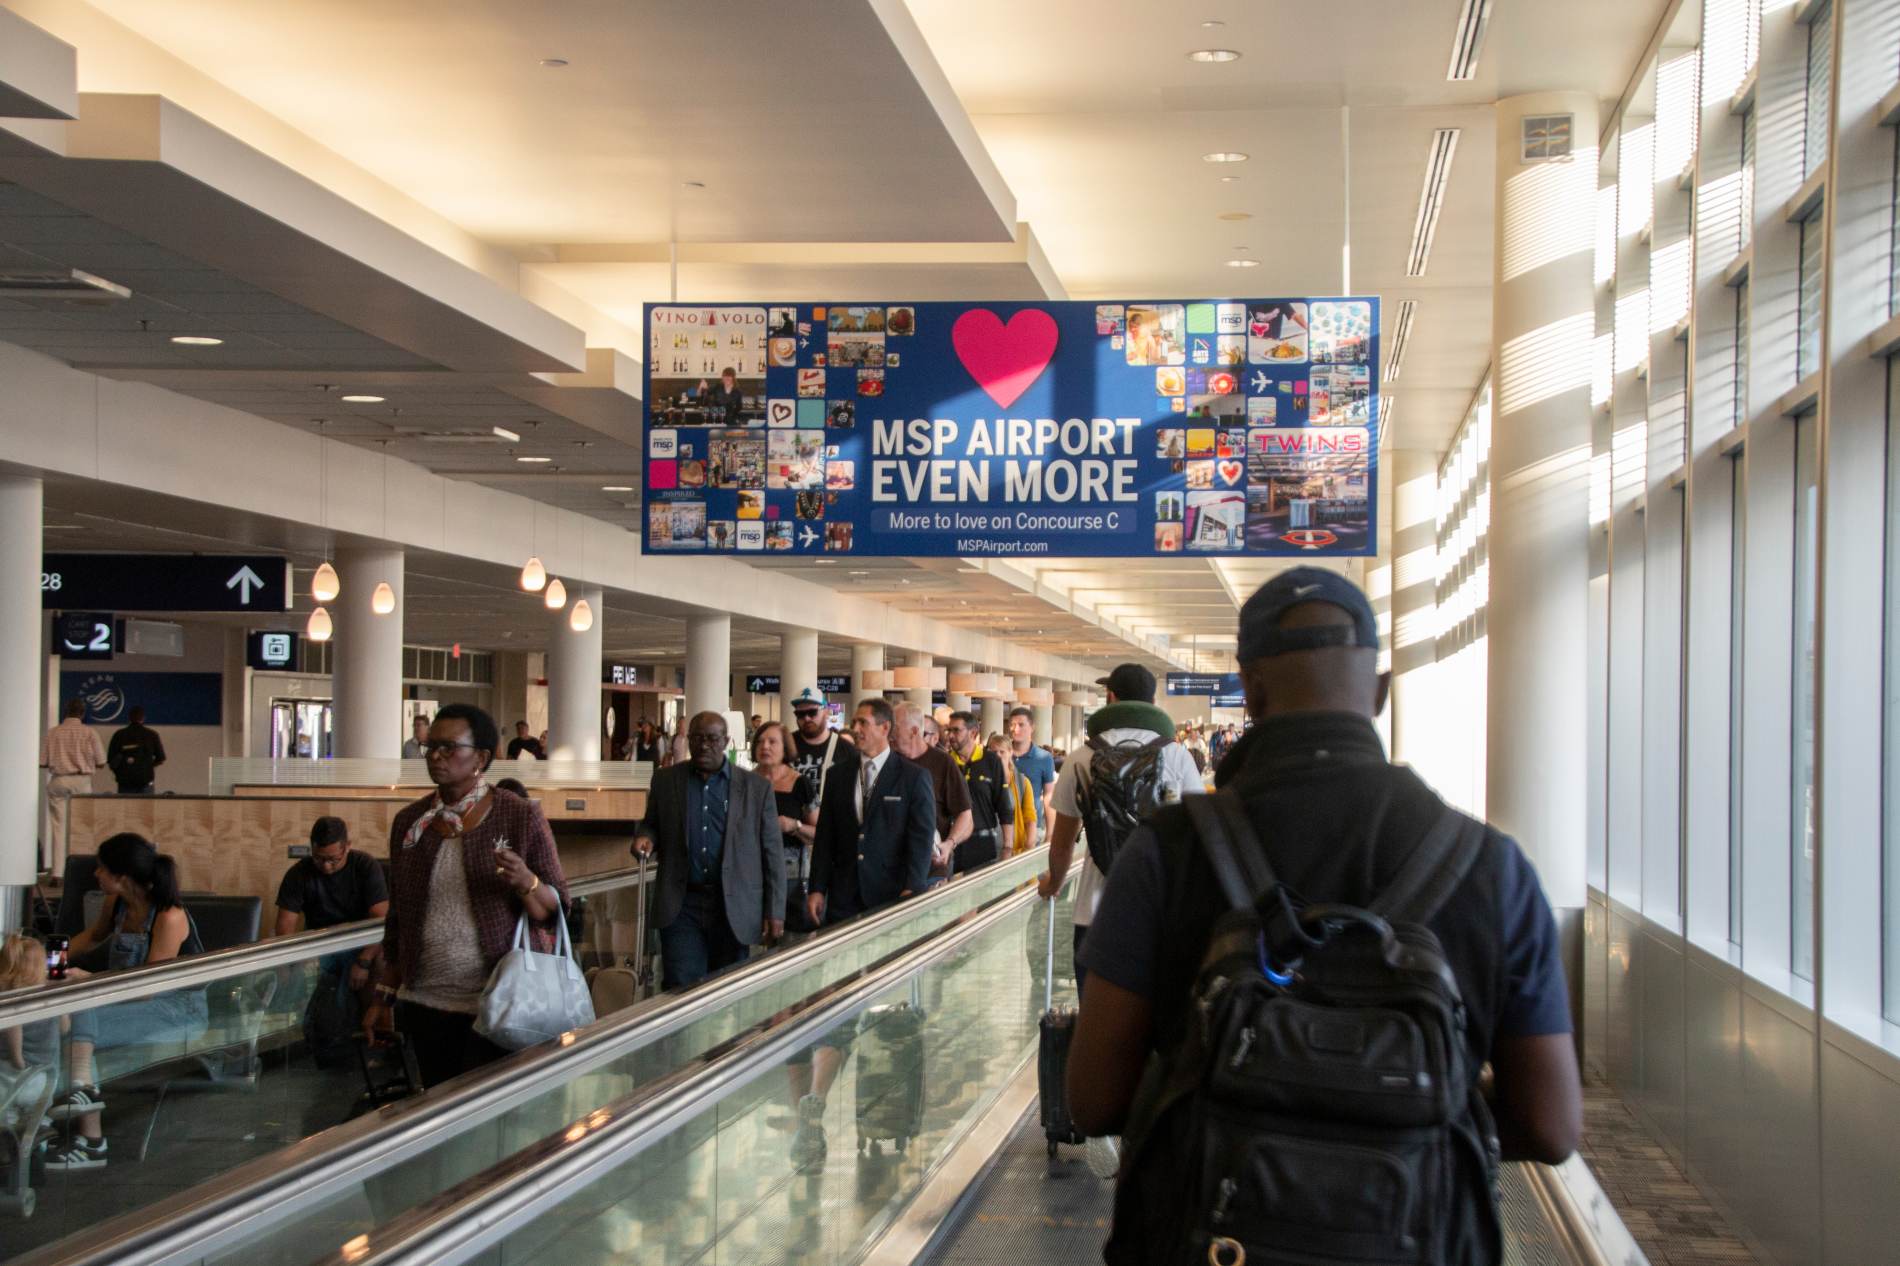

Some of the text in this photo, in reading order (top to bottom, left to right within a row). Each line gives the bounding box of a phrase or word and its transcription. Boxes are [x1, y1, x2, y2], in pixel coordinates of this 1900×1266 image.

[655, 312, 765, 325] VINO VOLO
[872, 418, 1141, 456] MSP AIRPORT
[1254, 433, 1361, 453] TWINS
[872, 459, 1138, 502] EVEN MORE
[889, 511, 1119, 529] More to love on Concourse C
[740, 532, 761, 542] msp
[957, 539, 1048, 554] MSPAirport.com
